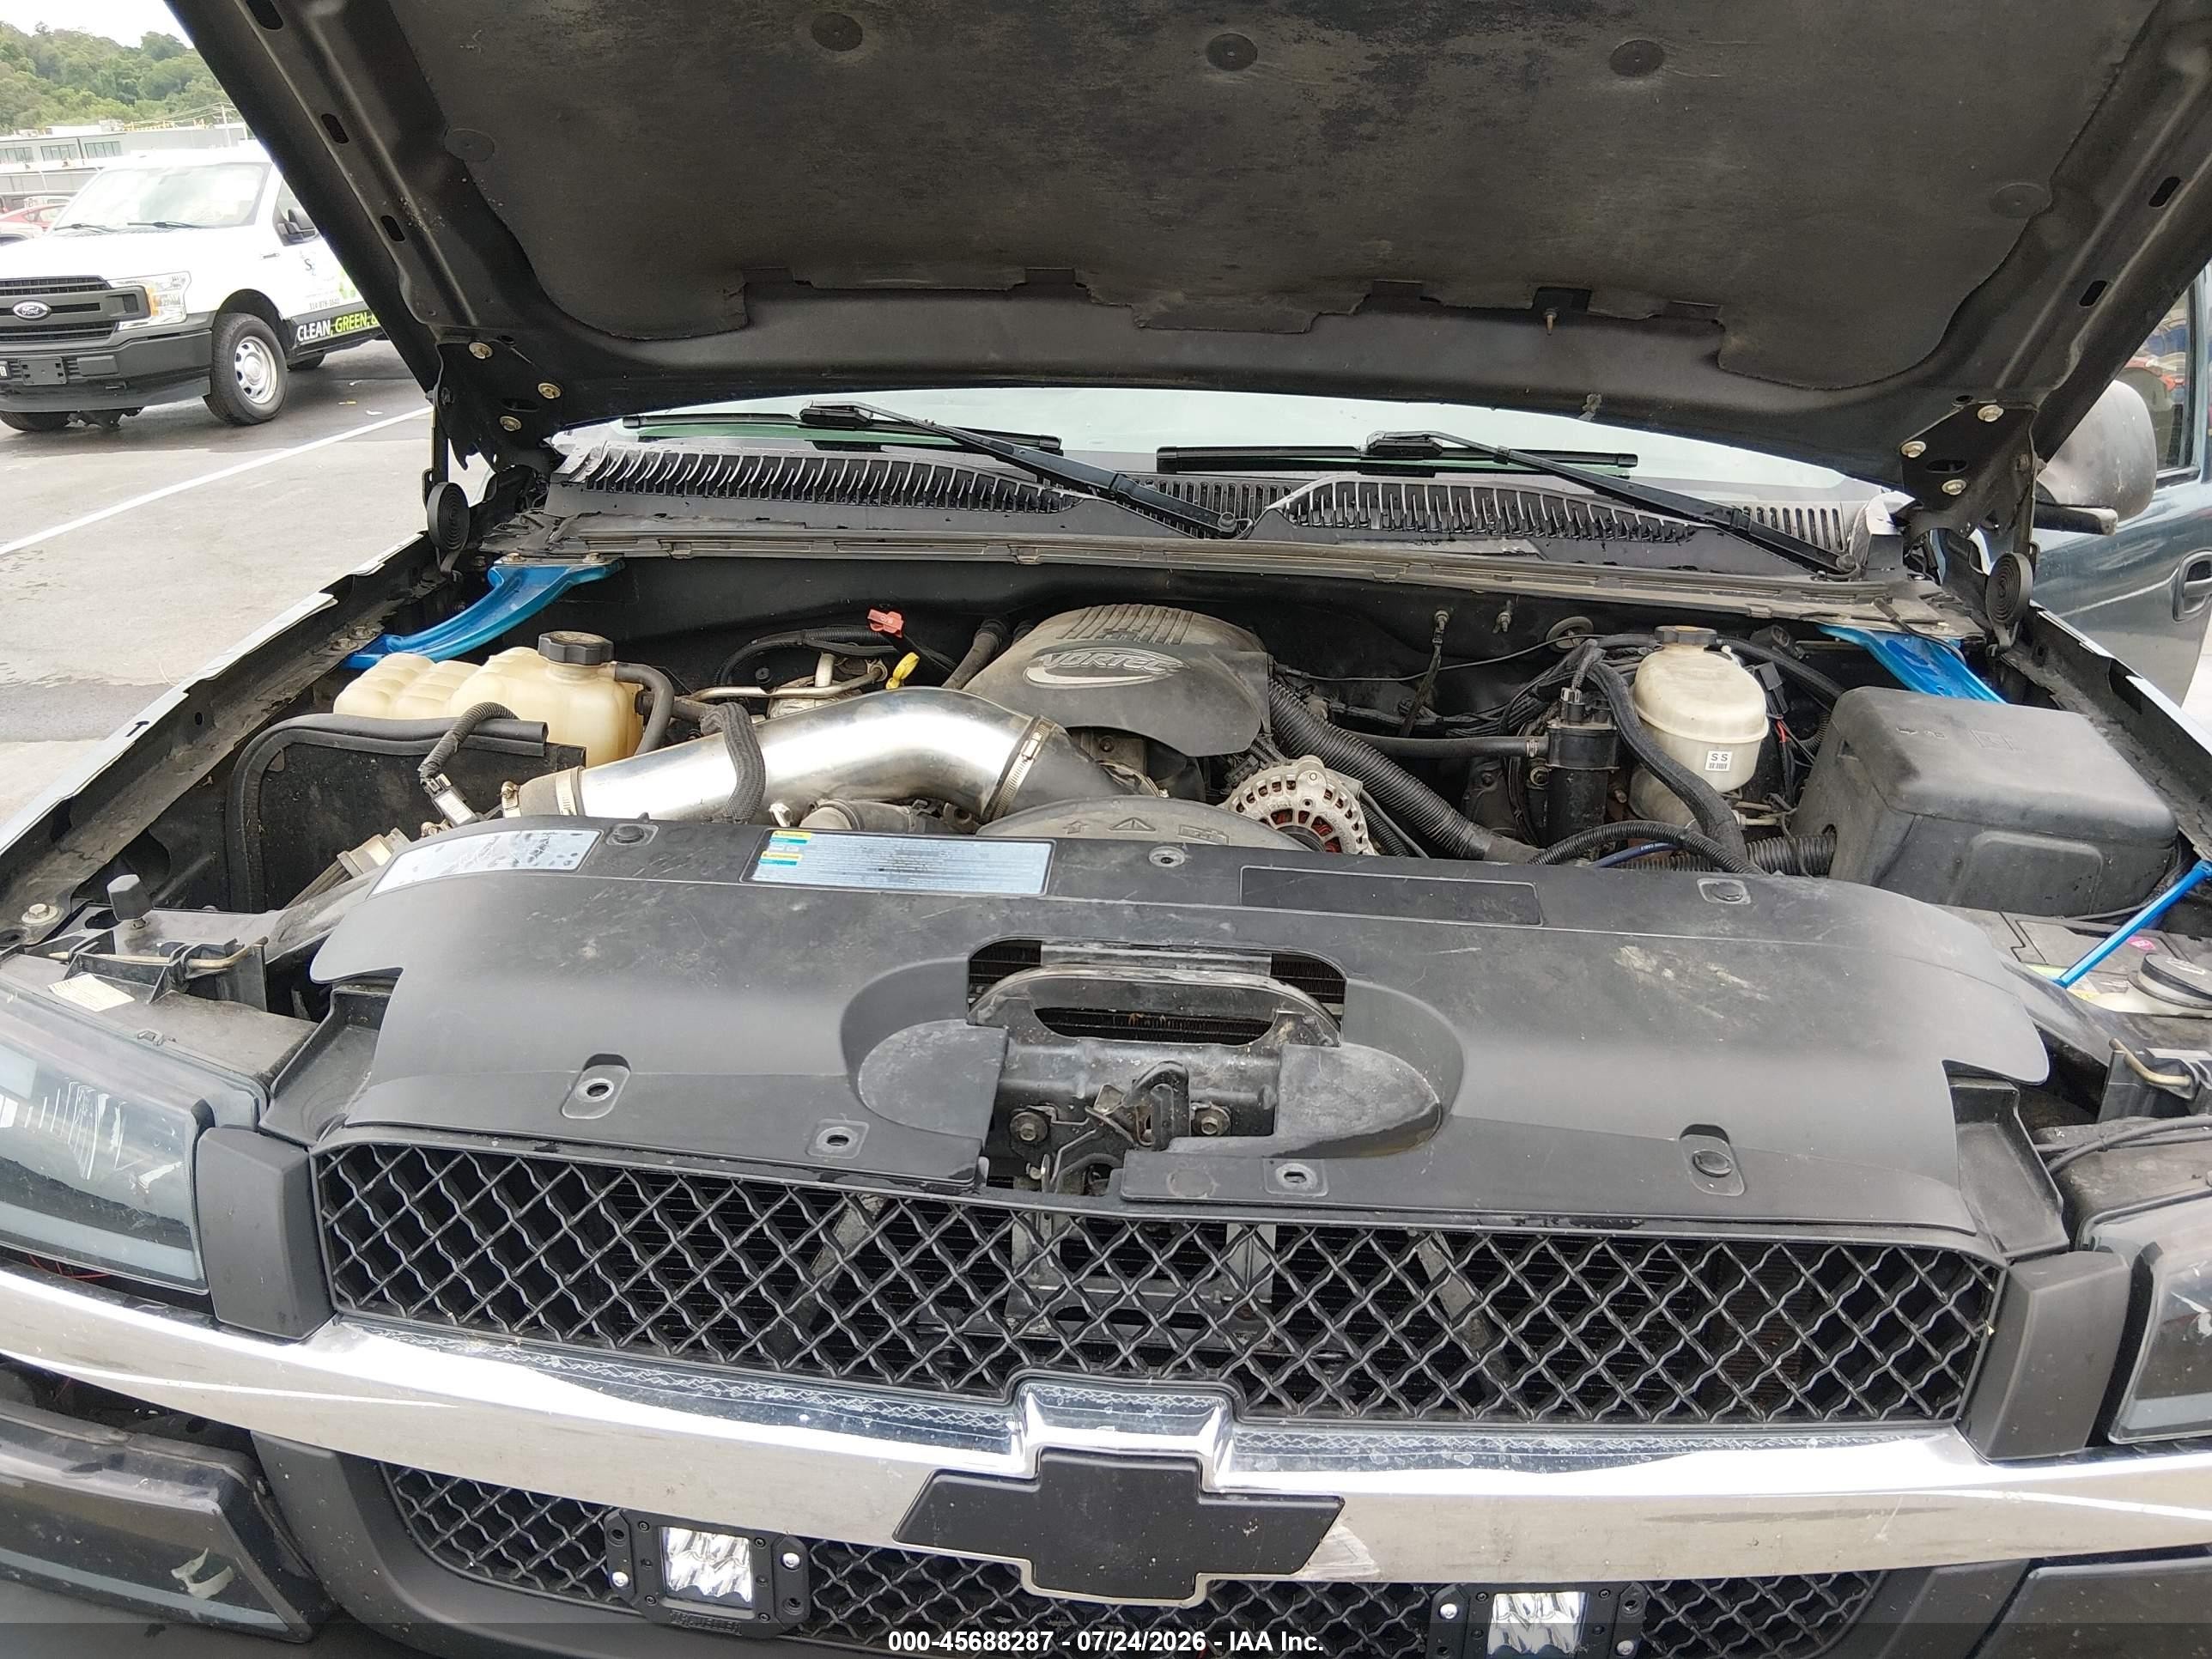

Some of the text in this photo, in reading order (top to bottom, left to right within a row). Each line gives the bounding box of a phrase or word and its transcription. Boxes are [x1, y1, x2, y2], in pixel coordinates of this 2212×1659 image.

[297, 319, 333, 342] CLEAN,
[335, 312, 370, 333] GREEN,
[1039, 653, 1183, 673] VORTEC
